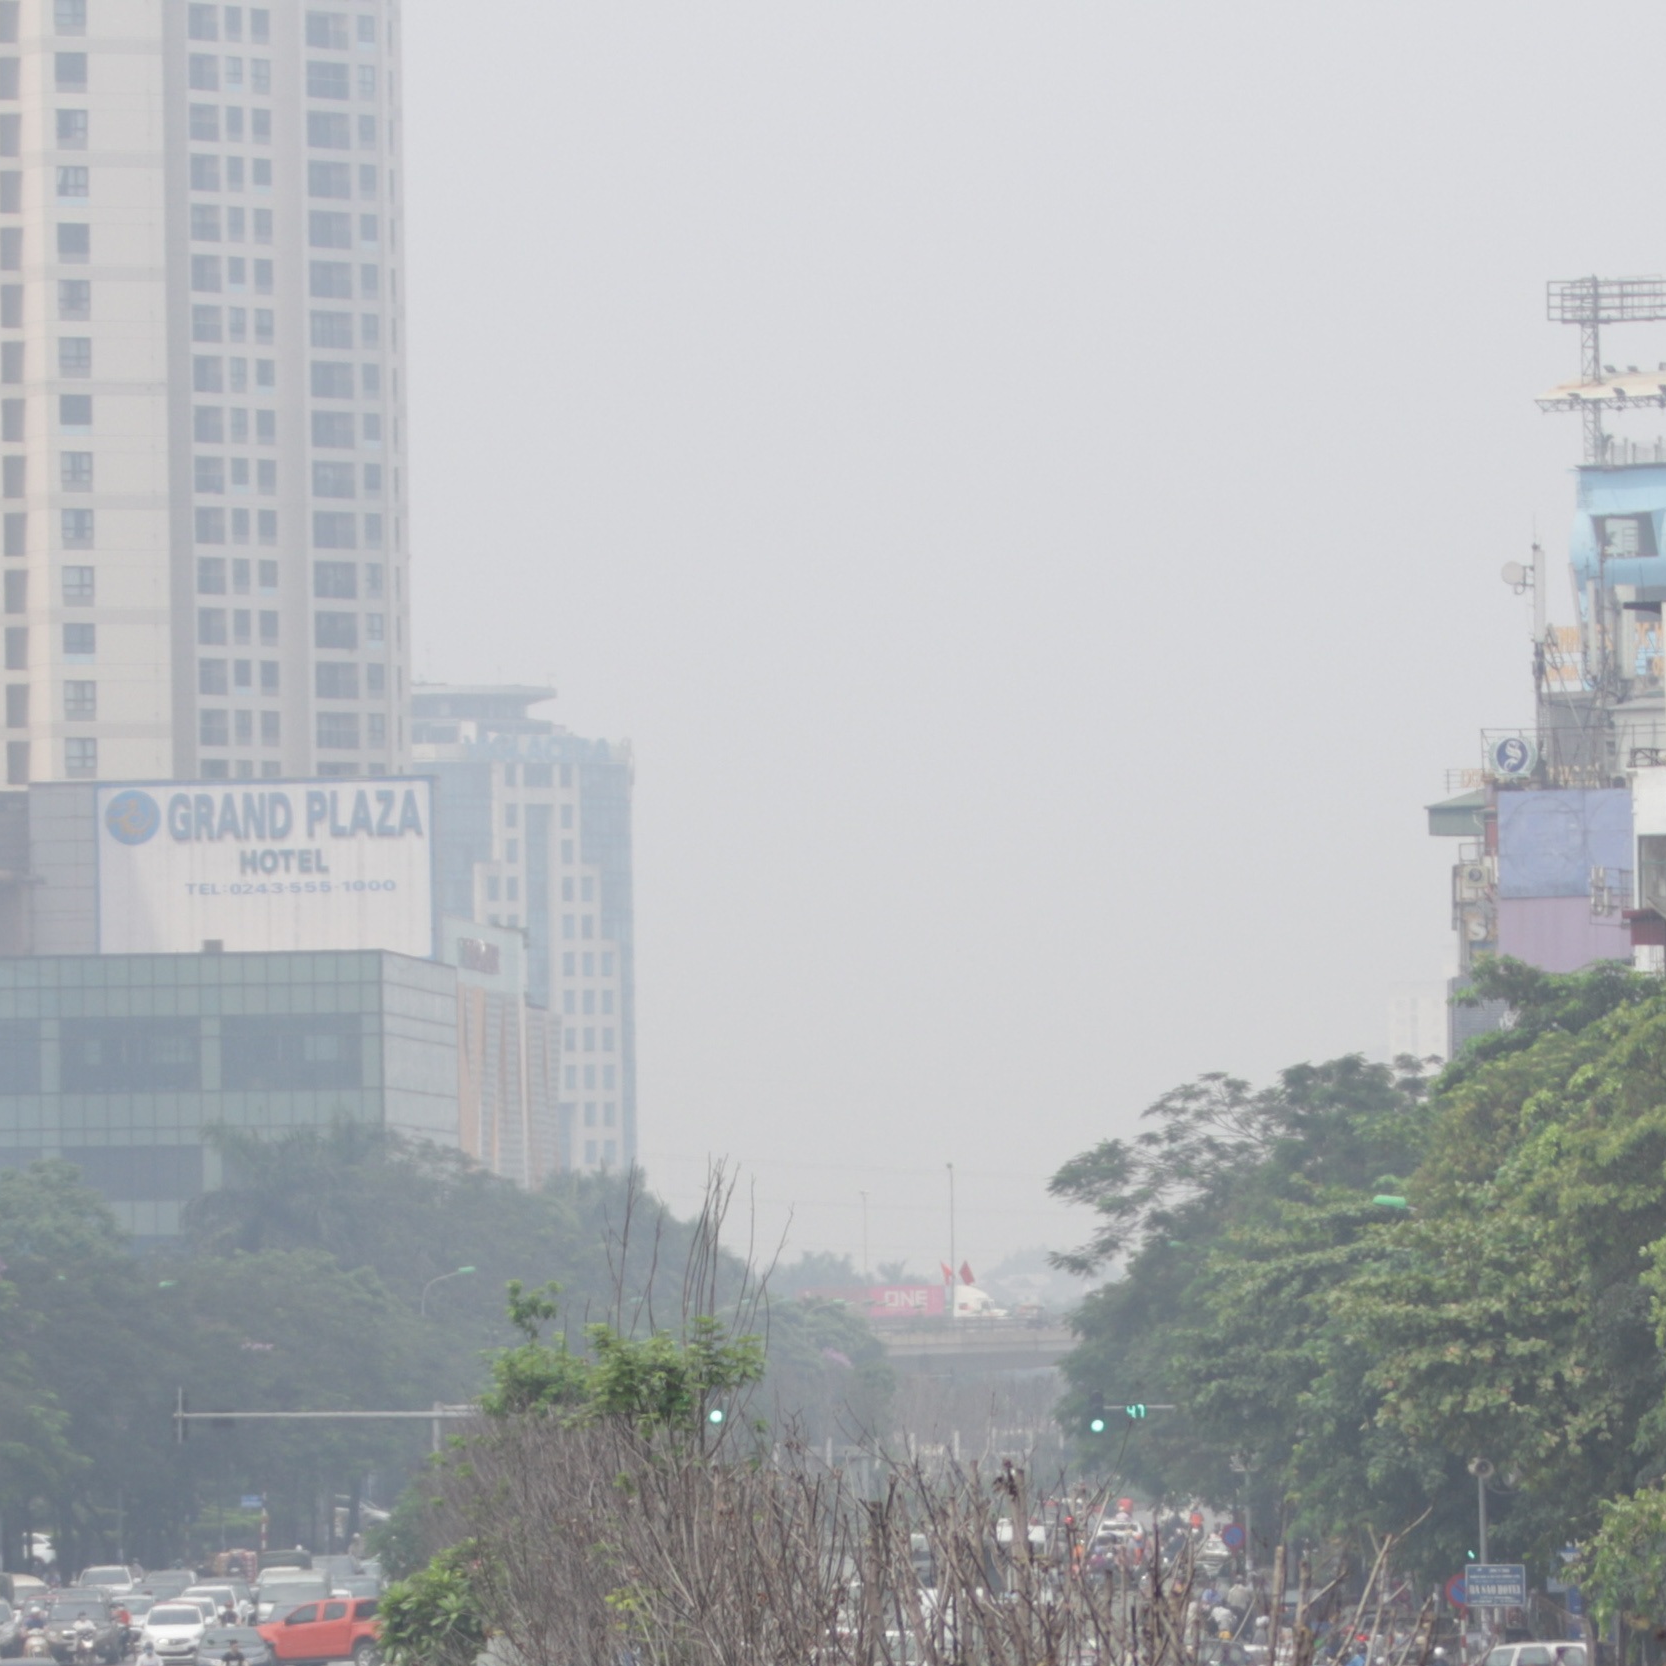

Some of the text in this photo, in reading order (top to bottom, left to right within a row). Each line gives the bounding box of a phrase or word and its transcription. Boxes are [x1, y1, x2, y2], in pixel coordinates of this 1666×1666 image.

[167, 788, 423, 841] GRAND PLAZA
[239, 848, 329, 875] HOTEL
[884, 1289, 927, 1307] ONE
[1126, 1403, 1144, 1419] 47
